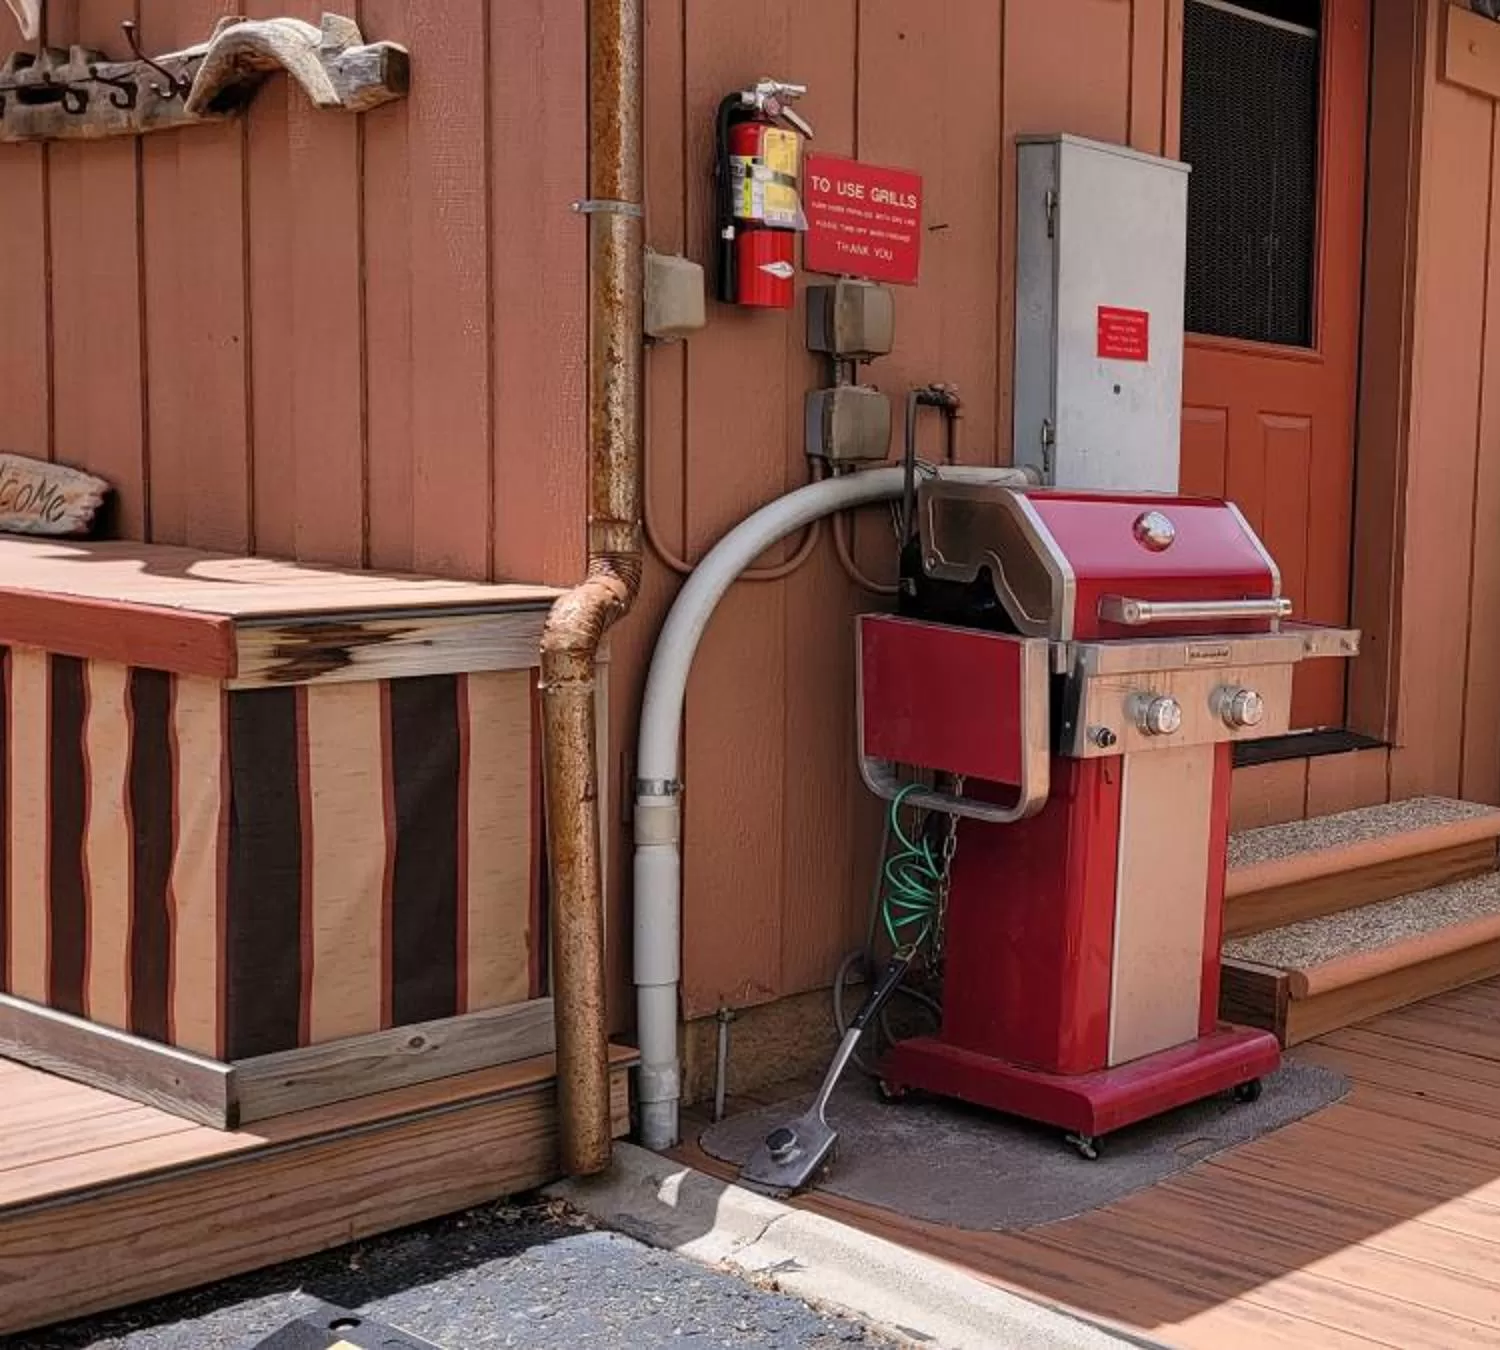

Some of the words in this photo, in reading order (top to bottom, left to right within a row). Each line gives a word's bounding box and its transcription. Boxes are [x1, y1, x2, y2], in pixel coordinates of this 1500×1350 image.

[811, 175, 831, 193] TO
[837, 180, 865, 199] USE
[871, 187, 917, 209] GRILLS
[836, 240, 870, 256] THANK
[874, 247, 893, 261] YOU
